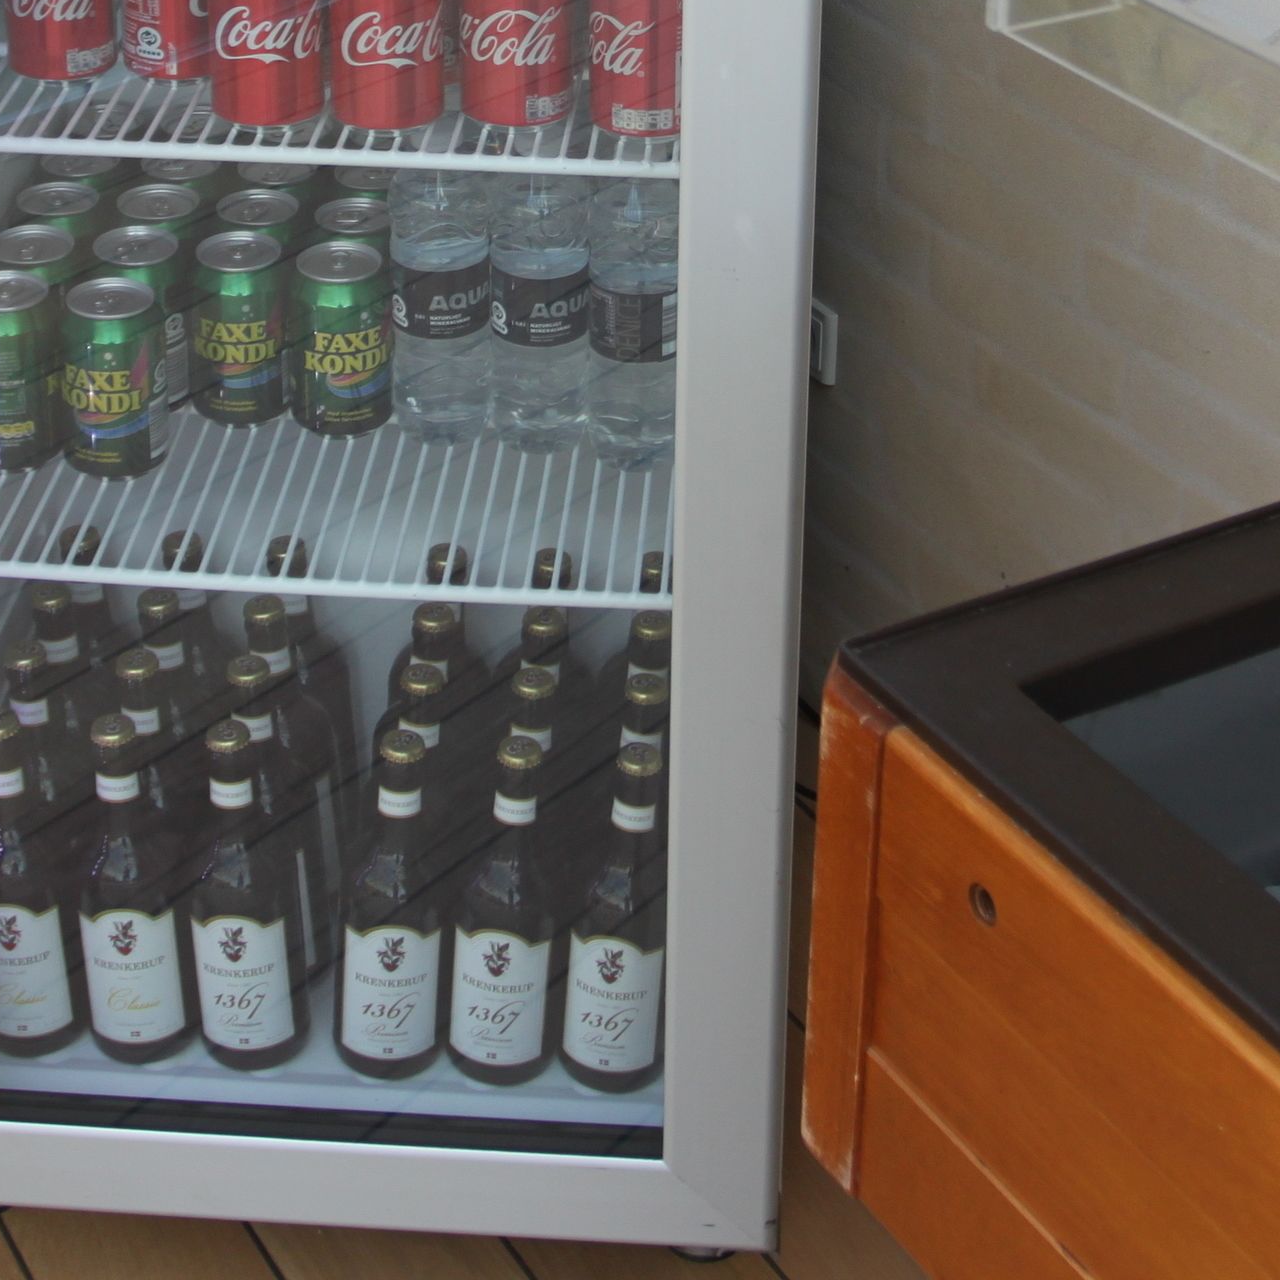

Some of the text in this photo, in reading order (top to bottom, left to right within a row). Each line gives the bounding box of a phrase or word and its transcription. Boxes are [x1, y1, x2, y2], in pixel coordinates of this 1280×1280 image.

[200, 318, 267, 343] FAXE
[314, 325, 382, 353] FAXE
[194, 336, 278, 364] KONDI
[304, 344, 389, 375] KONDI
[64, 362, 131, 392] FAXE
[63, 383, 142, 414] KONDI
[93, 955, 166, 972] KRENKERUP
[203, 961, 275, 978] KRENKERUP
[355, 971, 428, 989] KRENKERUP
[462, 974, 535, 994] KRENKERUP
[574, 980, 648, 1001] KRENKERUP
[106, 985, 162, 1011] Classic
[213, 982, 271, 1020] 1367
[361, 992, 421, 1029] 1367
[467, 1001, 526, 1035] 1367
[580, 1007, 639, 1042] 1367
